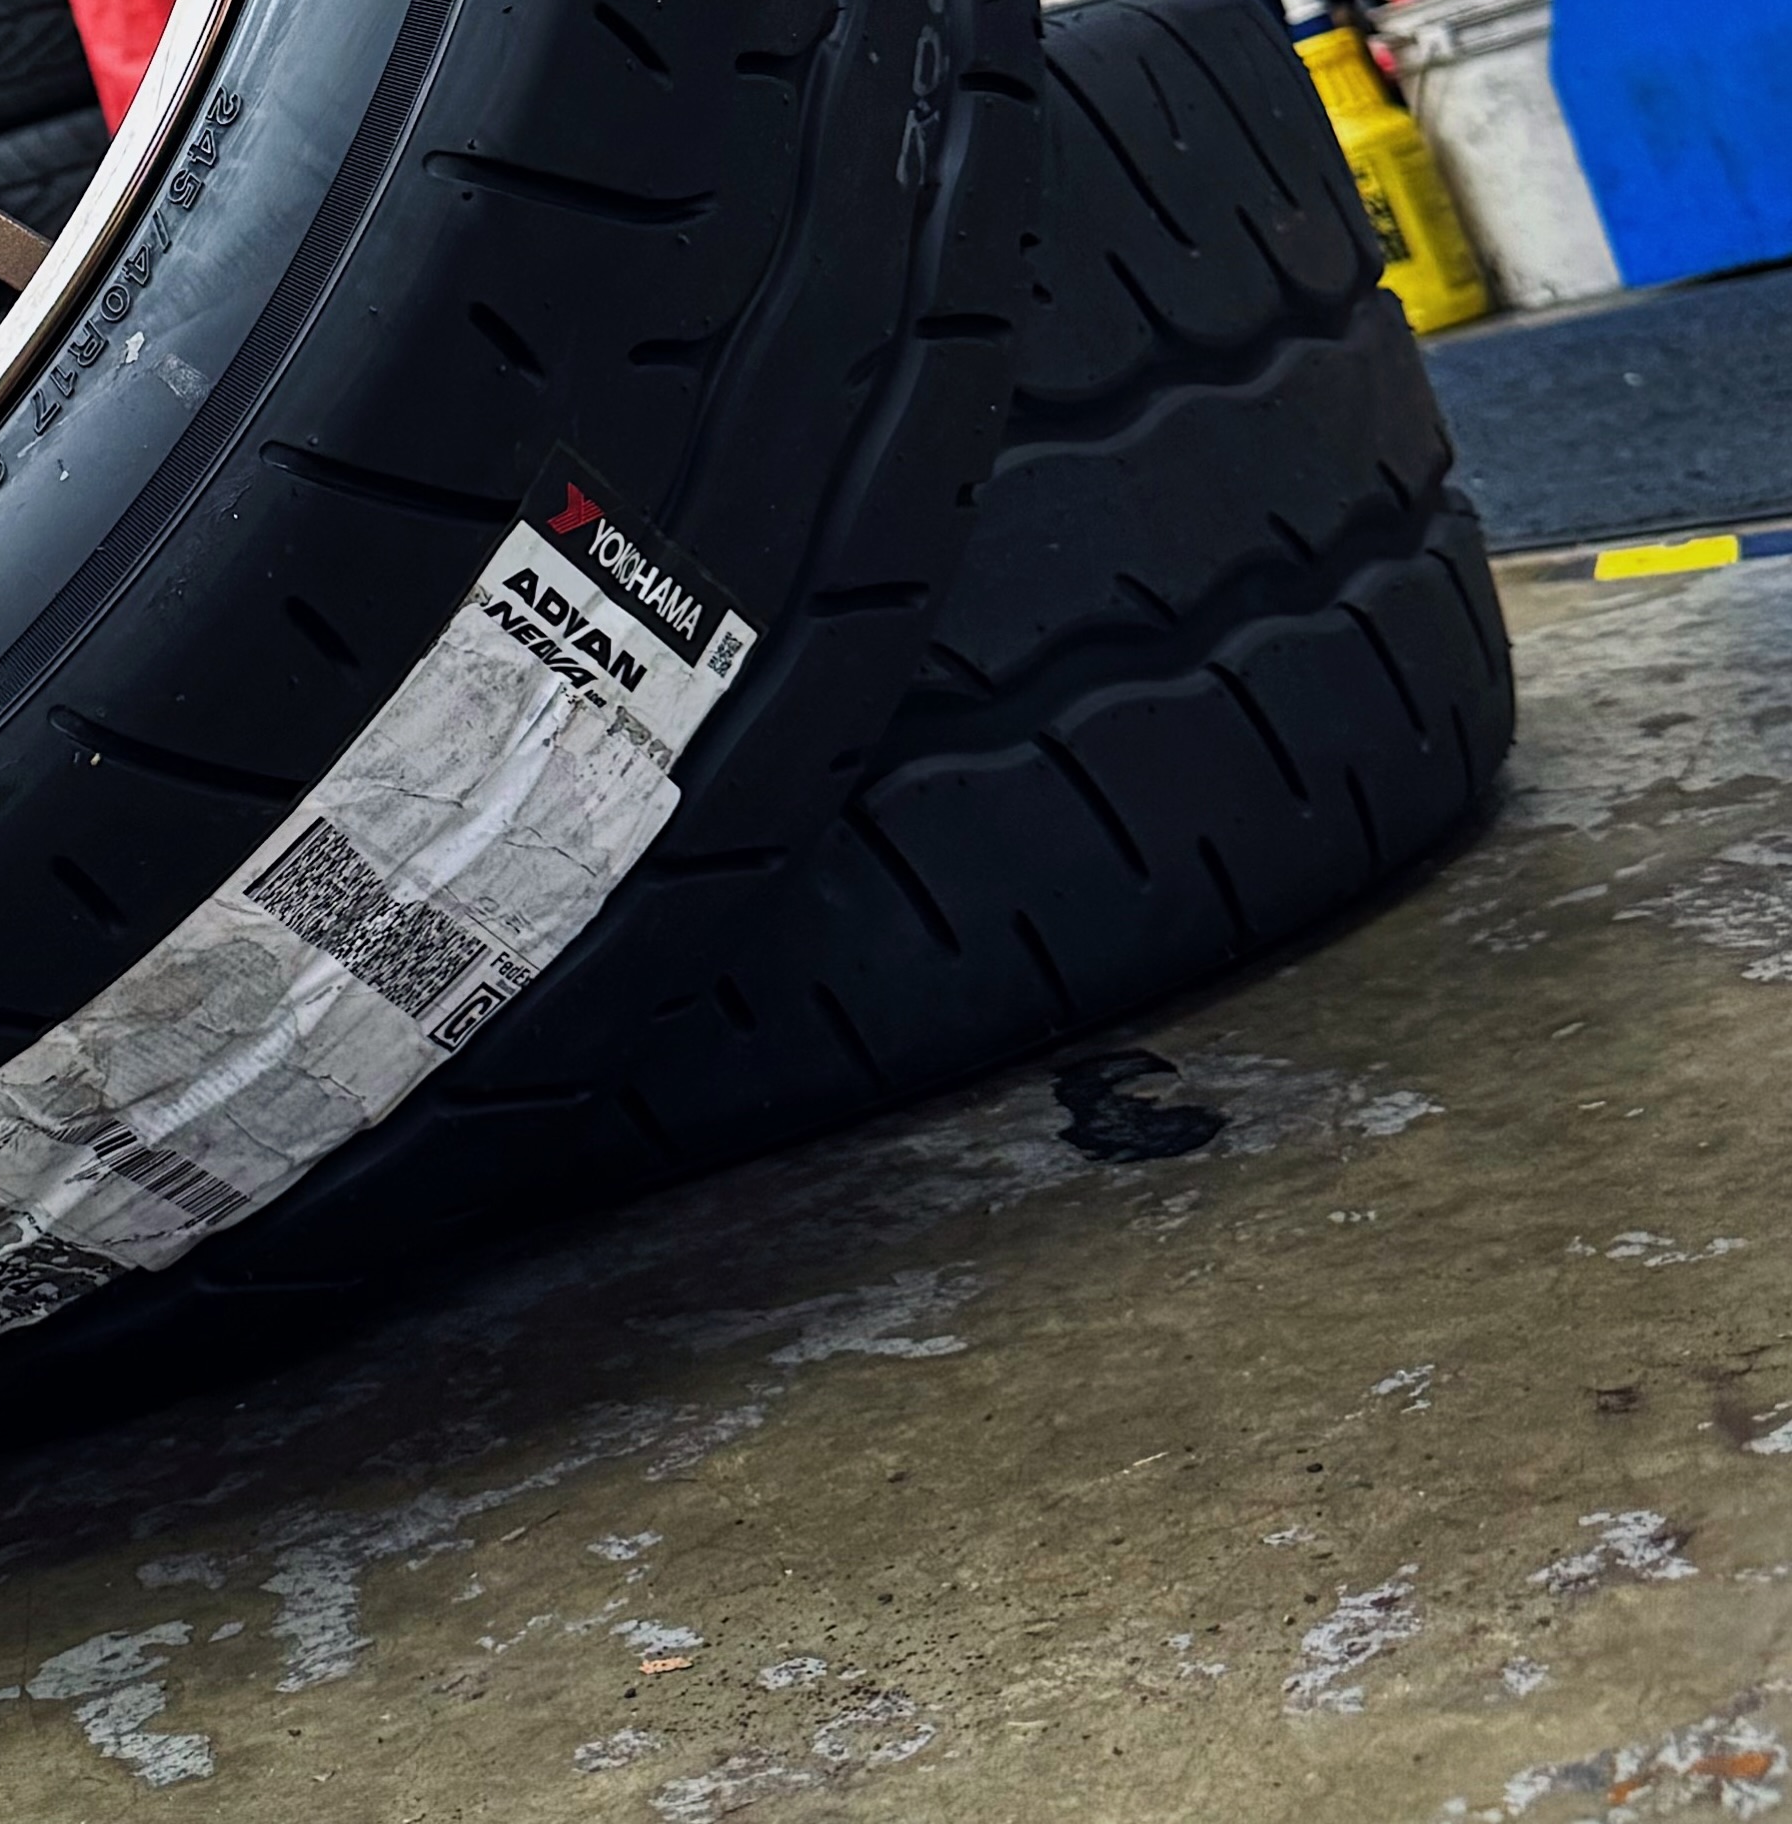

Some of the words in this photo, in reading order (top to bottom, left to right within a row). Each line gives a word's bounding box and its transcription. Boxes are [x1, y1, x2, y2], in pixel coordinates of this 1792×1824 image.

[26, 83, 244, 436] 245/40R17
[502, 567, 648, 693] ADVAN
[587, 518, 707, 641] YOKOHAMA
[444, 993, 492, 1043] G
